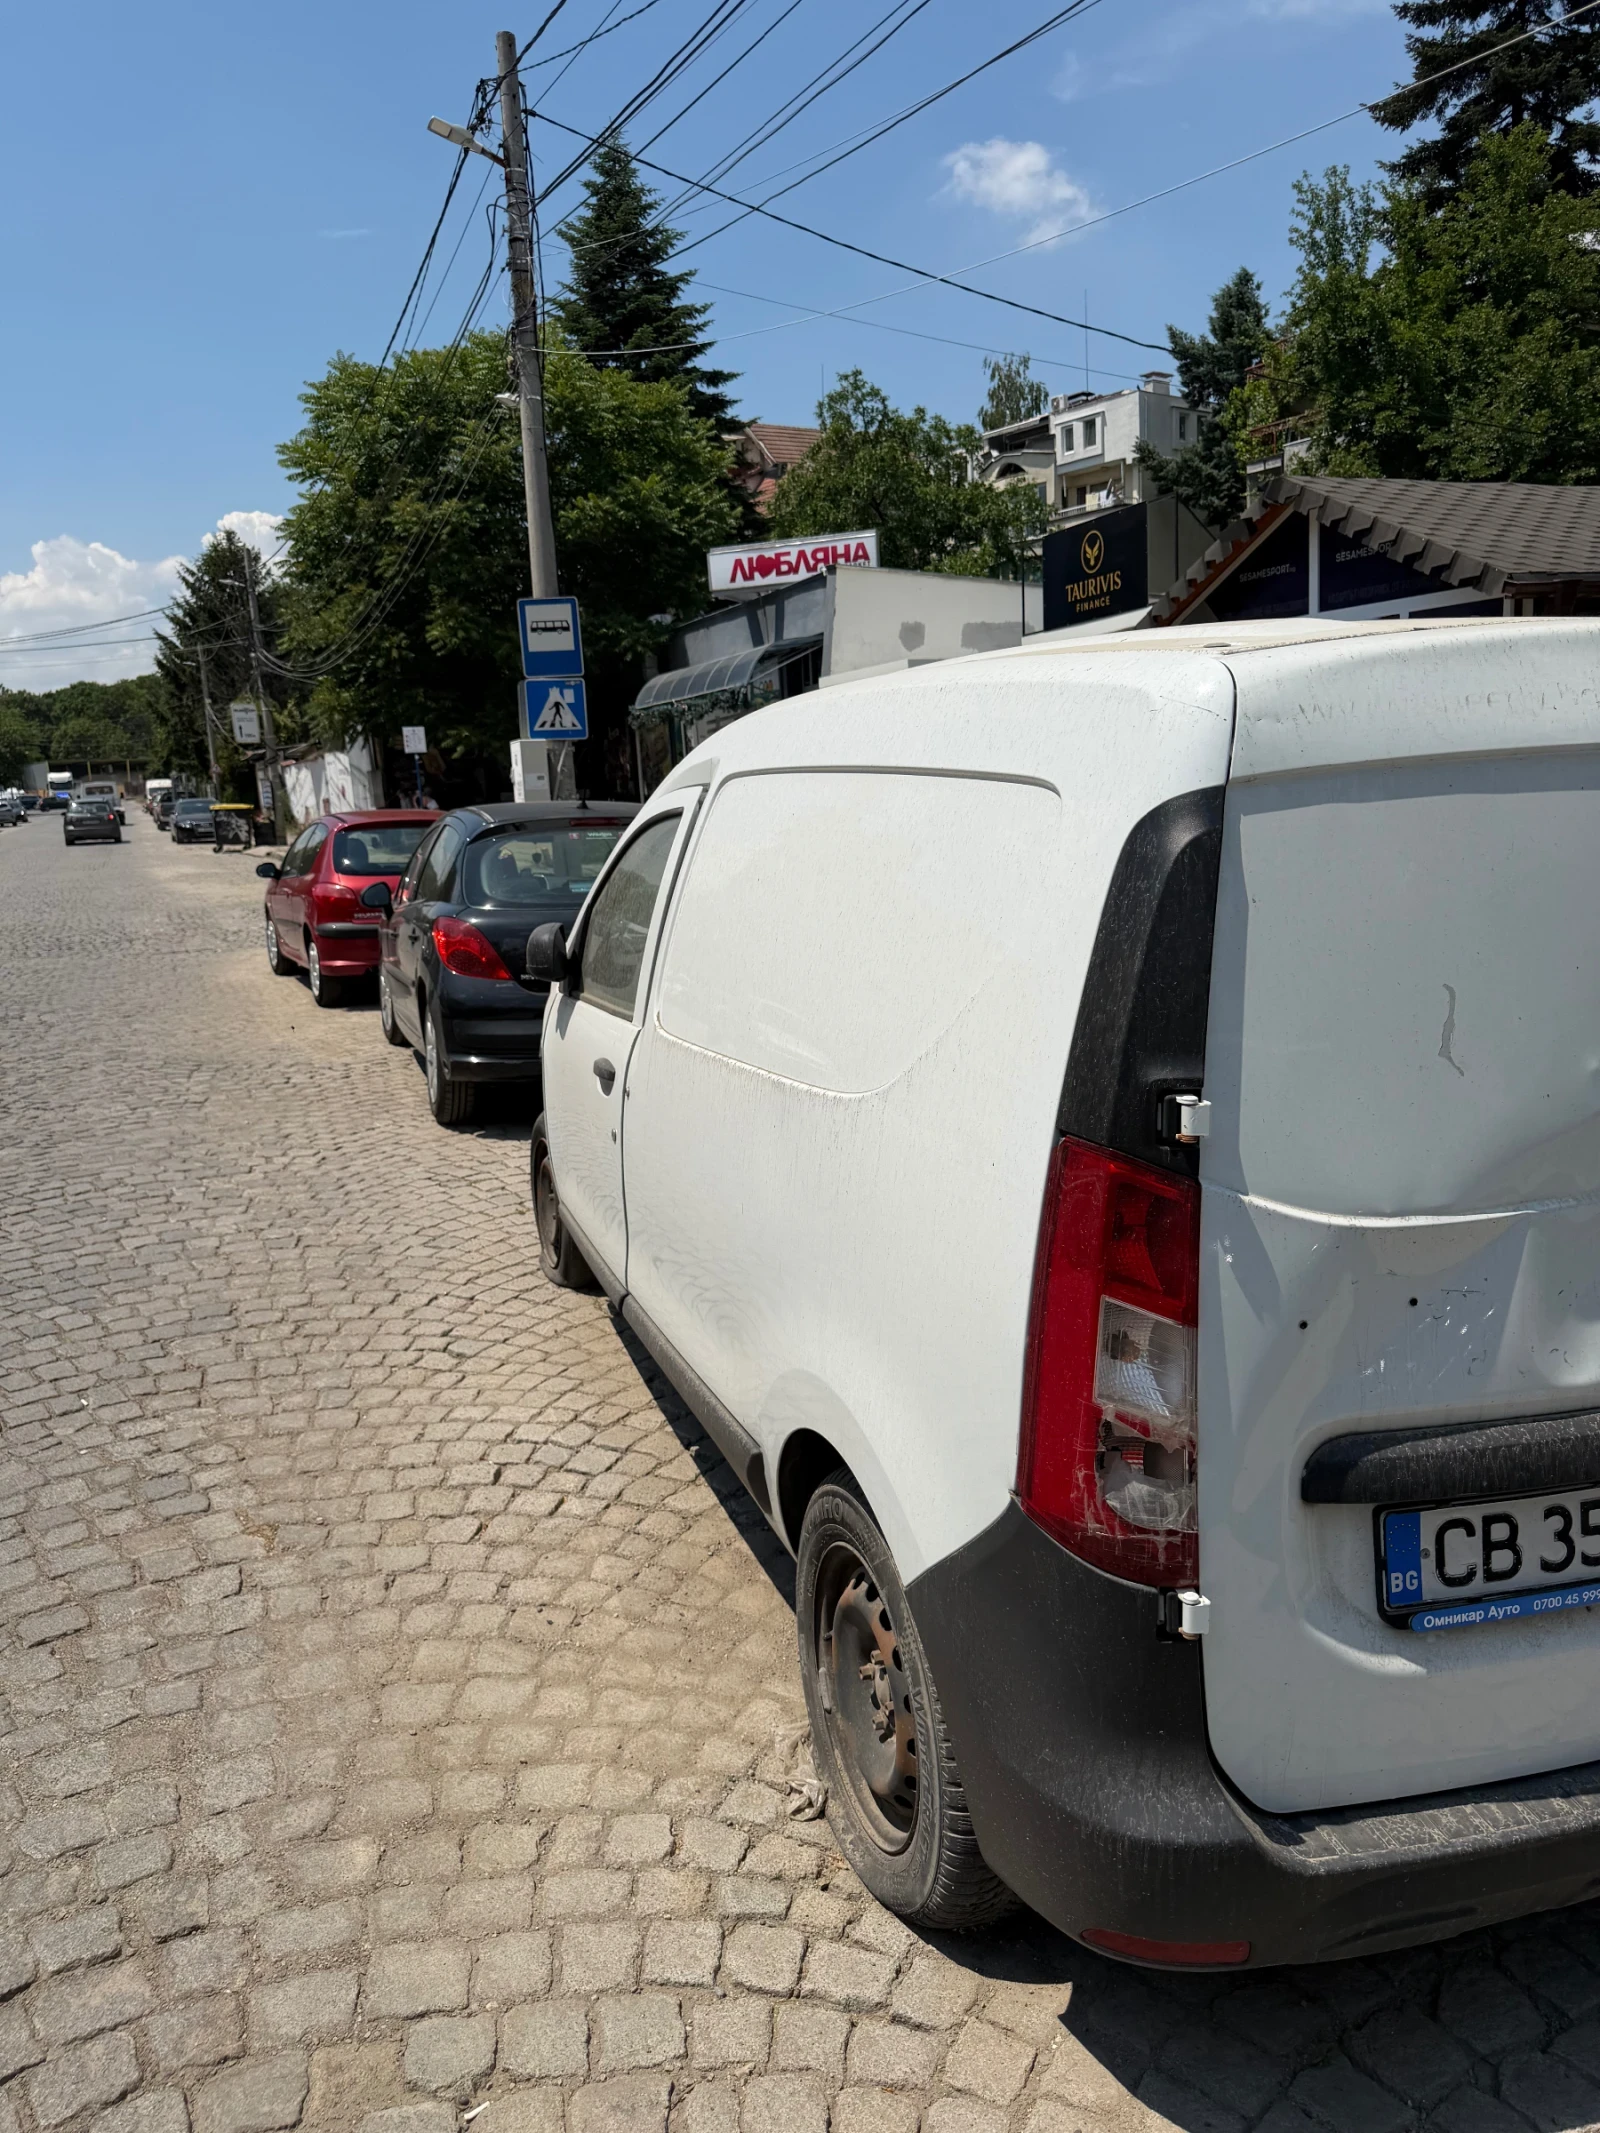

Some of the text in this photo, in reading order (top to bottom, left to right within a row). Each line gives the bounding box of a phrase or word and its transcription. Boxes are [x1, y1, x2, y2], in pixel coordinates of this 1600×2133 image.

[729, 542, 870, 583] ЛЮБЛЯНА
[1335, 542, 1393, 563] SESAMESOR
[1065, 570, 1122, 603] TAURIVIS
[1075, 596, 1111, 613] FINANCE
[1435, 1499, 1600, 1588] CB 35
[1390, 1570, 1419, 1593] BG
[1423, 1609, 1485, 1629] Омникар
[1488, 1602, 1521, 1620] Ауто
[1533, 1594, 1563, 1611] 0700
[1564, 1592, 1580, 1605] 45
